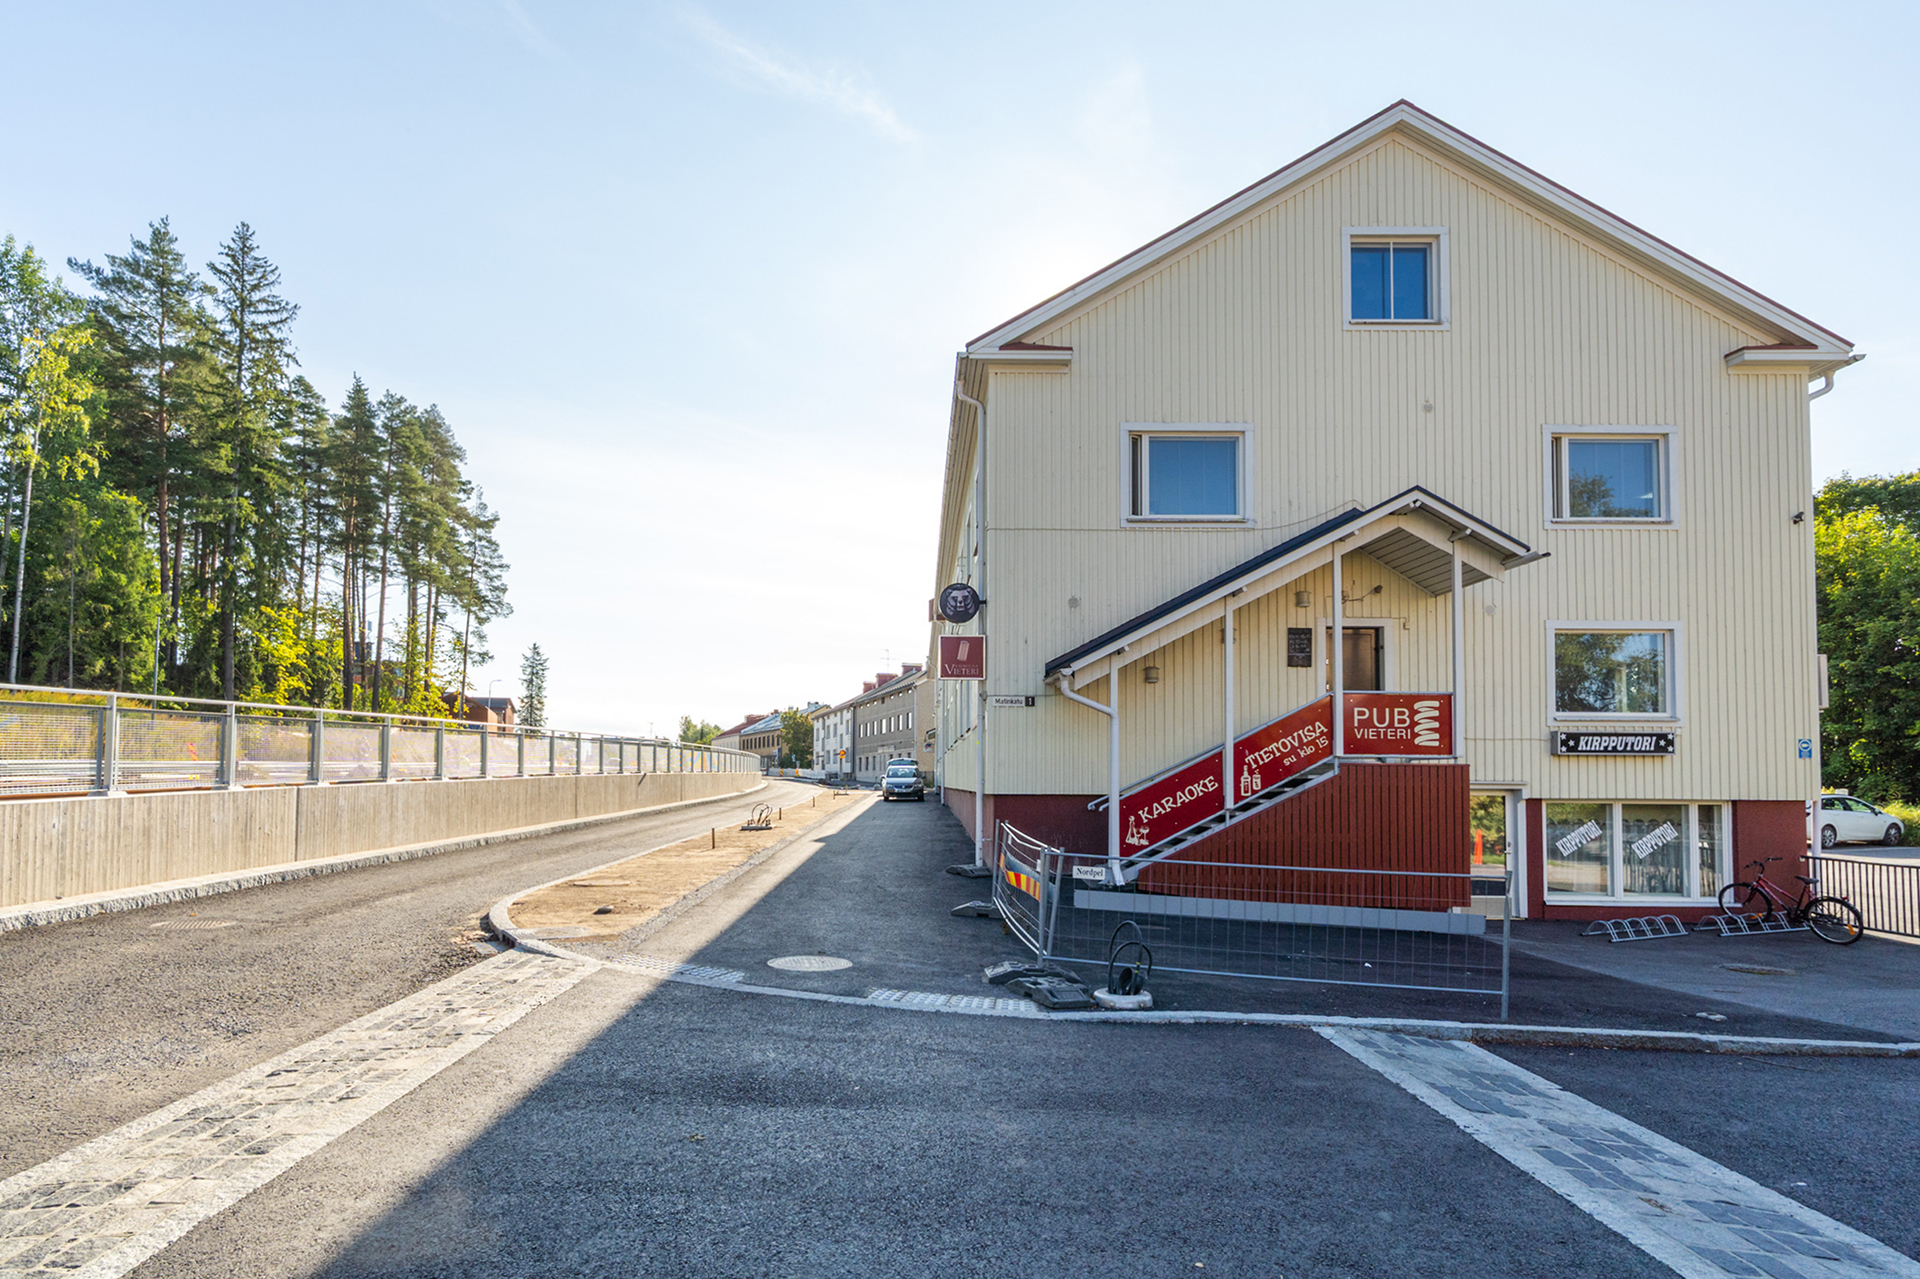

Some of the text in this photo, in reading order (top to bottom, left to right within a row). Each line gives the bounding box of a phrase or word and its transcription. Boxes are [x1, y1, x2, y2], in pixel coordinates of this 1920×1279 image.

[944, 663, 979, 675] VIETERI
[1353, 707, 1411, 728] PUB
[1354, 728, 1411, 739] VIETERI
[1577, 736, 1657, 751] KIRPPUTORI
[1244, 721, 1328, 769] TIETOVISA
[1283, 754, 1297, 766] su
[1297, 745, 1316, 758] klo
[1138, 775, 1219, 823] KARAOKE
[1555, 819, 1603, 857] KIRPPUTORI
[1631, 821, 1679, 859] KIRPPUTORI
[1076, 867, 1104, 878] Nordpel
